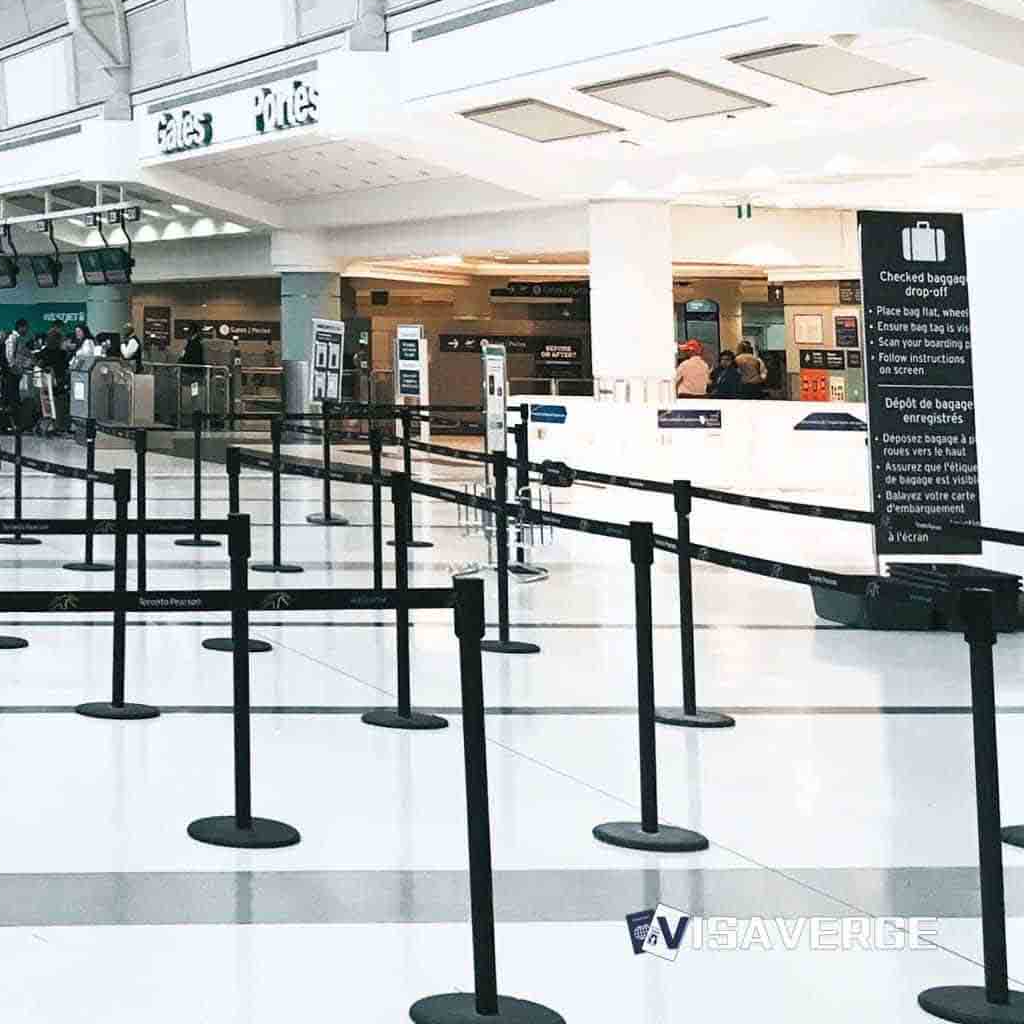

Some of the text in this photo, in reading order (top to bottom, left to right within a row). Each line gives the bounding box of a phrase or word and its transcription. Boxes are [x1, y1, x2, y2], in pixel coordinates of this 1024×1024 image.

[156, 81, 319, 154] Gates Portes
[879, 271, 967, 285] Checked baggag
[876, 305, 901, 316] Place
[903, 307, 919, 318] bag
[942, 308, 969, 317] wheel
[877, 321, 908, 332] Ensure
[910, 321, 927, 334] bag
[929, 323, 944, 334] tag
[878, 337, 900, 347] Scan
[902, 338, 922, 349] your
[924, 338, 963, 350] boarding
[879, 353, 965, 364] Follow instructions
[879, 366, 925, 375] on screen
[884, 397, 917, 411] Dépôt
[919, 398, 932, 409] de
[903, 413, 964, 425] enregistrés
[882, 433, 922, 445] Déposez
[924, 434, 959, 445] bagage
[883, 448, 910, 456] roues
[934, 447, 943, 456] le
[945, 447, 966, 456] haut
[885, 462, 978, 474] Assurez que l'étique
[885, 475, 897, 484] de
[899, 475, 933, 486] bagage
[935, 476, 950, 485] est
[925, 491, 949, 501] votre
[951, 491, 976, 501] carte
[886, 503, 965, 514] d'embarquement
[888, 532, 929, 542] à l'écran
